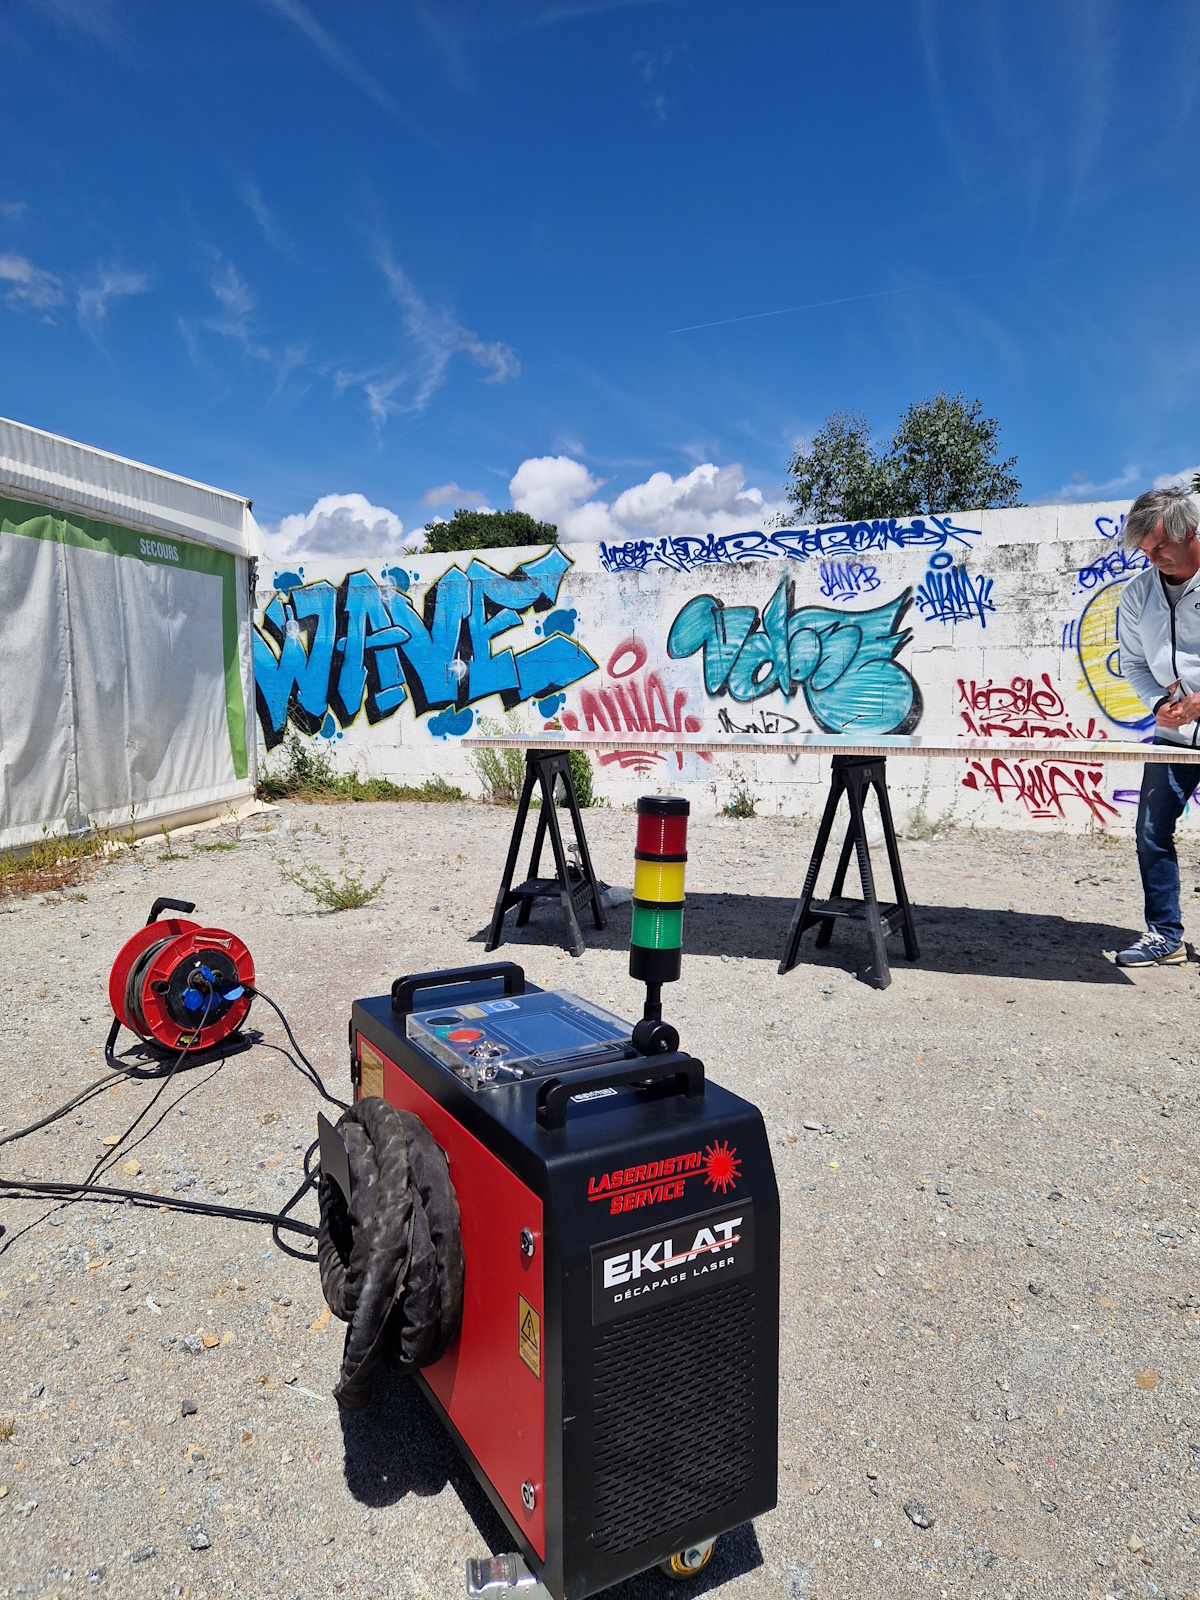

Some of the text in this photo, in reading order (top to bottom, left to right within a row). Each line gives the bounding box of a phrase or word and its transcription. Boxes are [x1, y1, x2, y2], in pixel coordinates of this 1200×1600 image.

[140, 538, 179, 561] SECOURS
[588, 1151, 702, 1194] LASERDISTRI
[610, 1180, 685, 1215] SERVICE
[603, 1217, 743, 1288] EKLAT
[614, 1257, 735, 1303] DÉCAPAGE LASER
